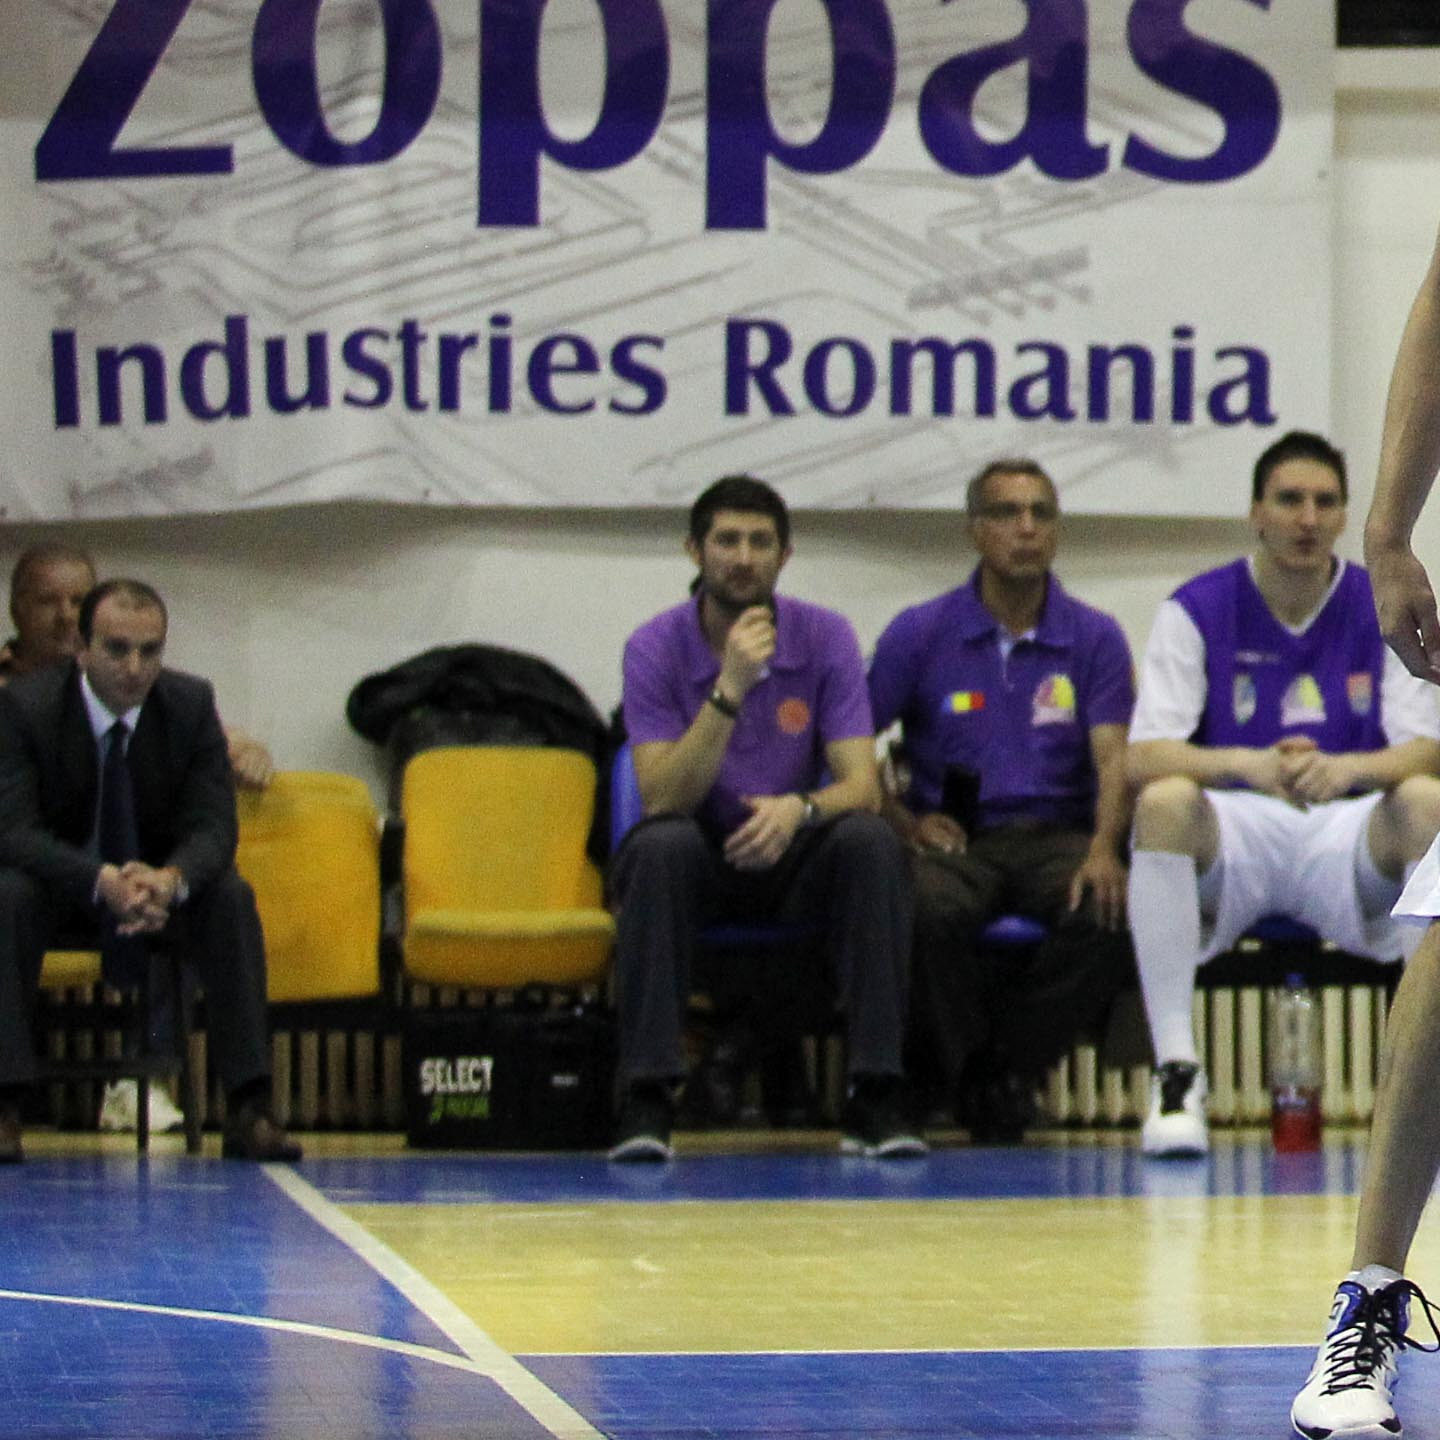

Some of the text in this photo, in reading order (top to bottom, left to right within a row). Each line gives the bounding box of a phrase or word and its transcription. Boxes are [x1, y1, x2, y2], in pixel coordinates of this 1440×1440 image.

[51, 314, 1279, 430] Industries Romania
[420, 1056, 494, 1095] SELECT
